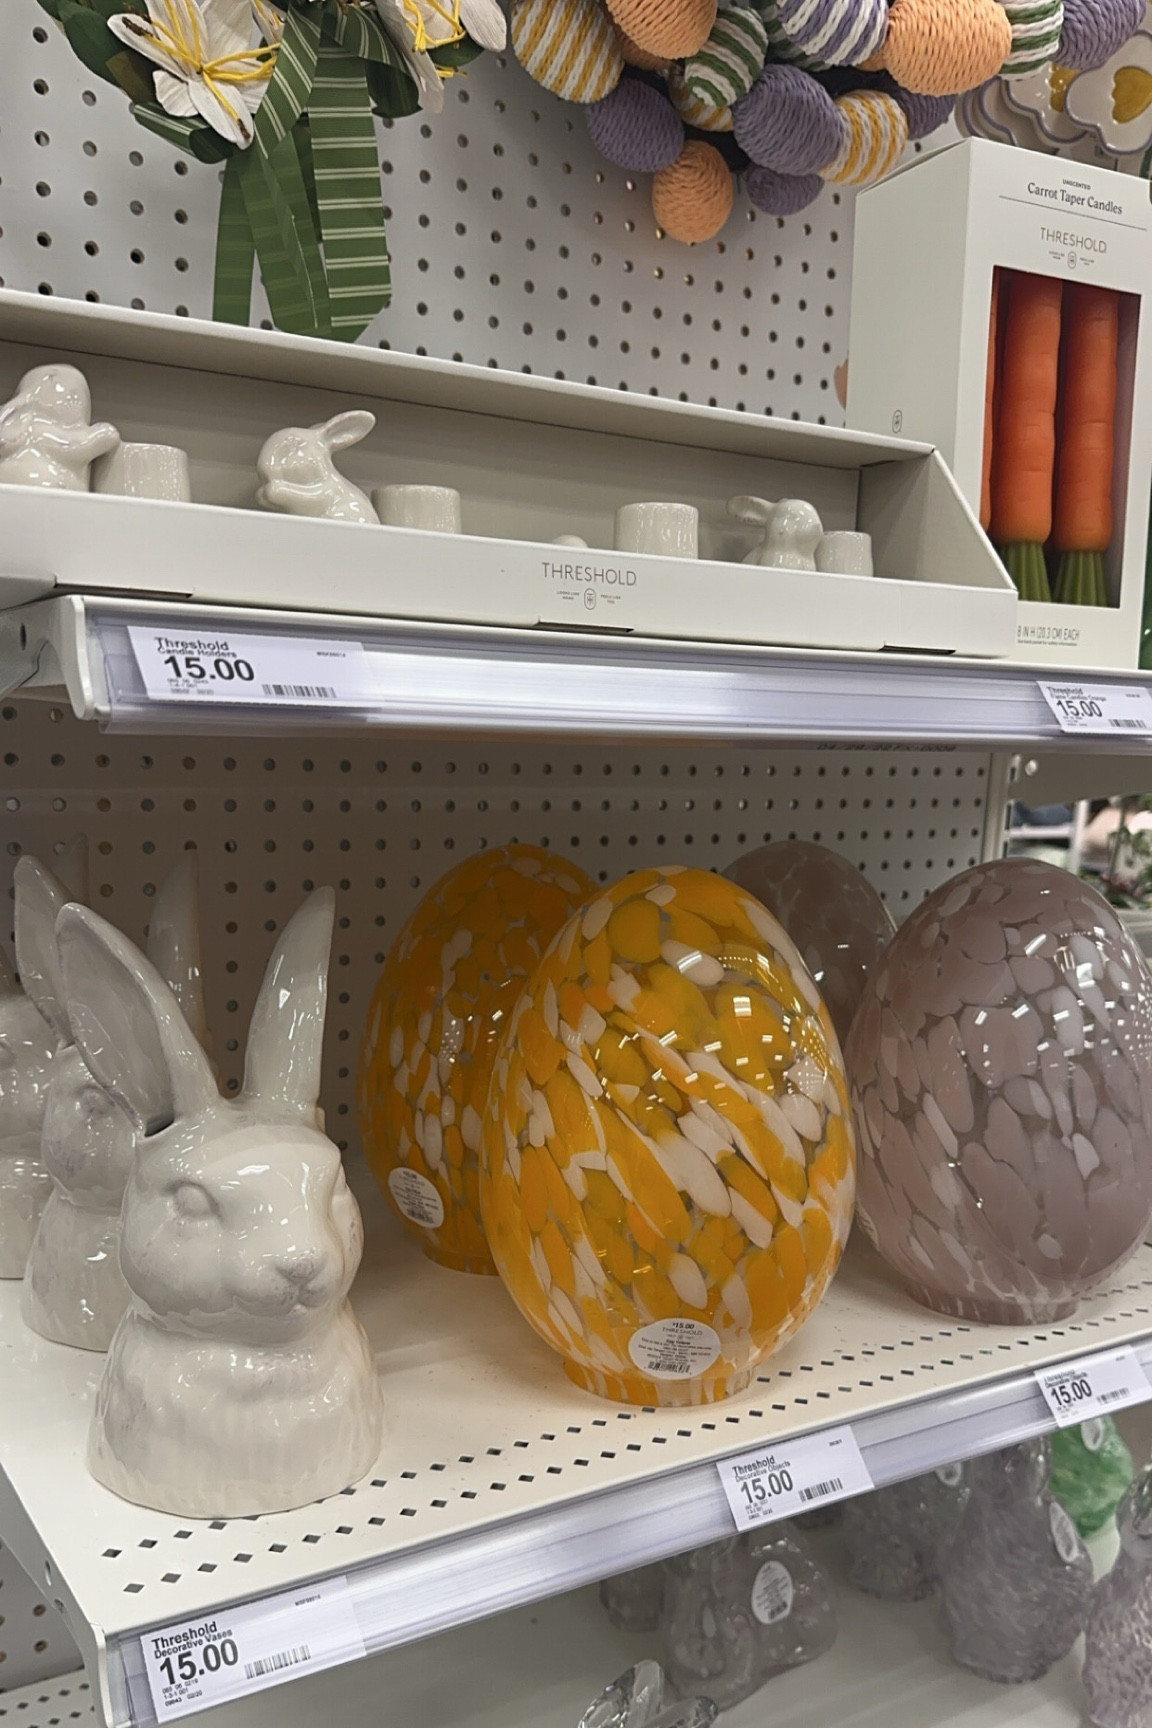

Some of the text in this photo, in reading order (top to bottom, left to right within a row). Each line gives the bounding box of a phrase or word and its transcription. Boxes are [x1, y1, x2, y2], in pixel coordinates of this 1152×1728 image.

[1062, 179, 1091, 190] UNSCENTED
[1027, 182, 1123, 215] Carrot Taper Candles
[1040, 227, 1108, 254] THRESHOLD
[541, 562, 637, 586] THRESHOLD
[154, 637, 229, 651] Threshold
[1063, 628, 1080, 641] EACH
[157, 647, 237, 658] Candle Holders
[164, 655, 255, 681] 15.00
[1056, 700, 1103, 718] 15.00
[1051, 1379, 1092, 1406] 15.00
[732, 1455, 775, 1477] Threshold
[735, 1460, 791, 1482] Decorative Objects
[740, 1469, 793, 1503] 15.00
[151, 1621, 217, 1651] Threshold
[154, 1629, 233, 1659] Decorative Vases
[159, 1638, 239, 1685] 15.00
